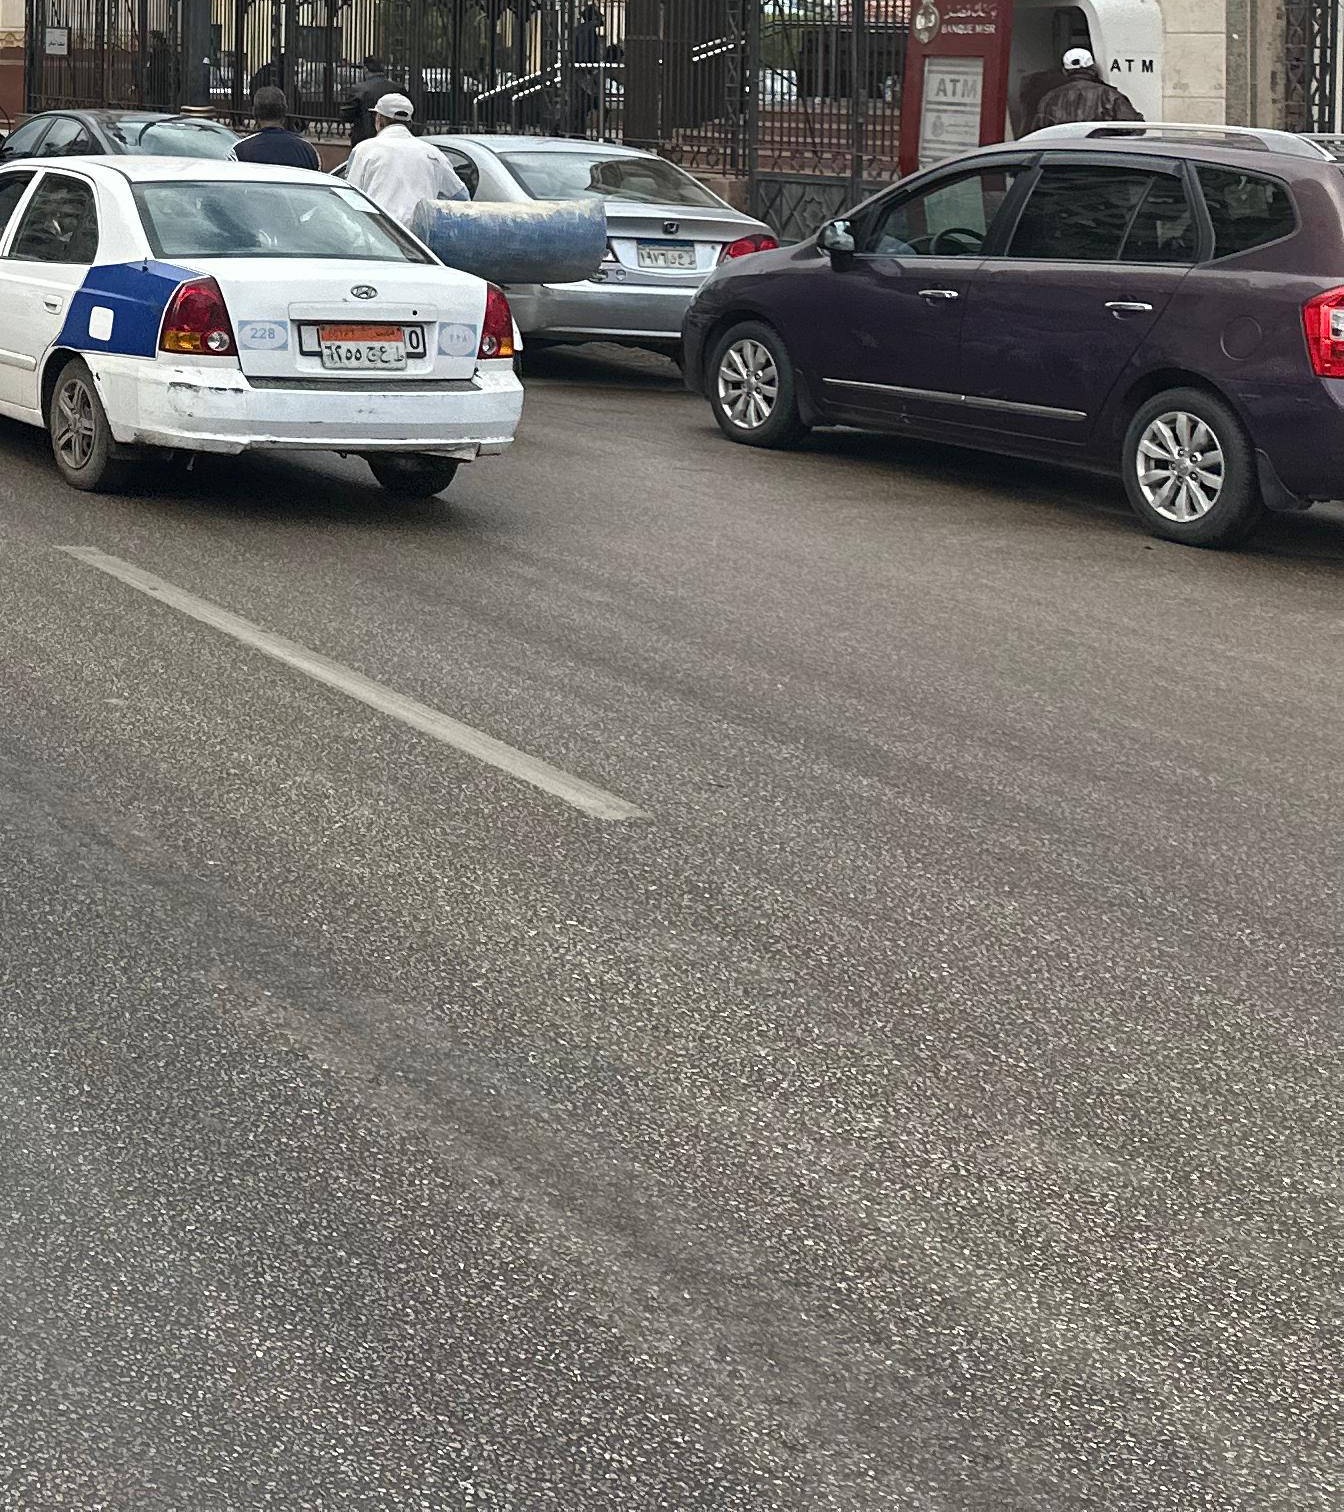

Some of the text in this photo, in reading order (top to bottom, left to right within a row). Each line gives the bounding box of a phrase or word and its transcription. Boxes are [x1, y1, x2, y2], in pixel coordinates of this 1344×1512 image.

[1110, 58, 1154, 73] ATM
[935, 77, 978, 99] ATM
[250, 327, 276, 339] 228
